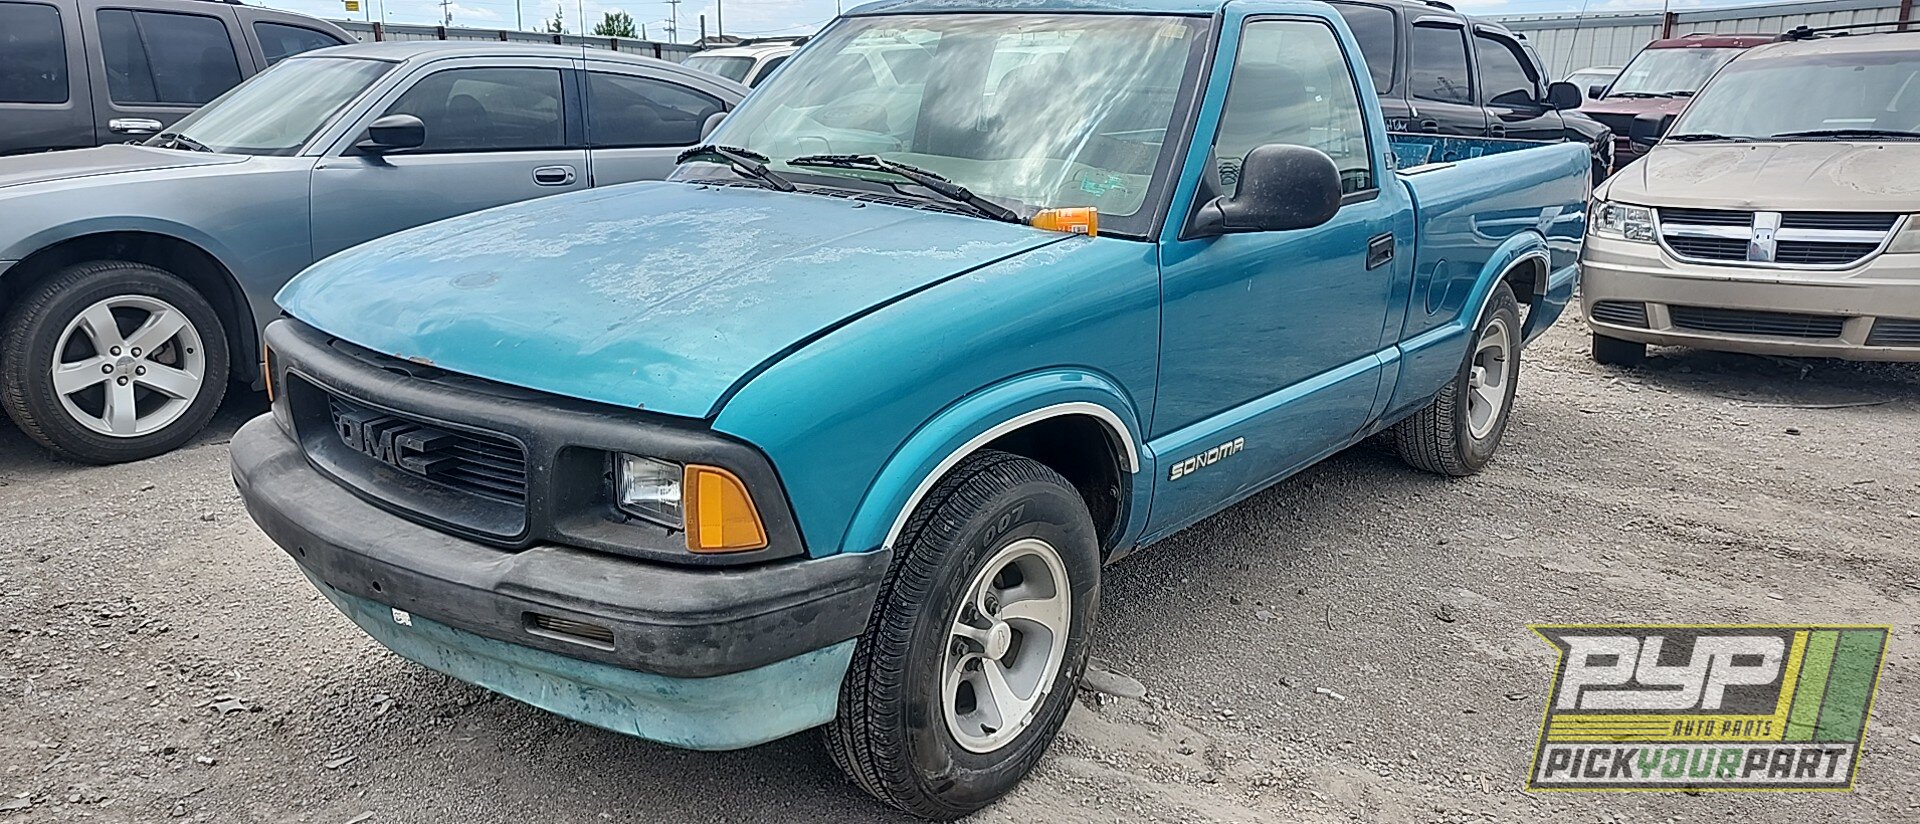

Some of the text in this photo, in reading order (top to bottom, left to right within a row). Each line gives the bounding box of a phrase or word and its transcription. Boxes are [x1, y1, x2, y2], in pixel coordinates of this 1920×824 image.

[340, 413, 430, 475] GMC
[1168, 436, 1245, 481] SONOMA
[984, 504, 1025, 547] 007
